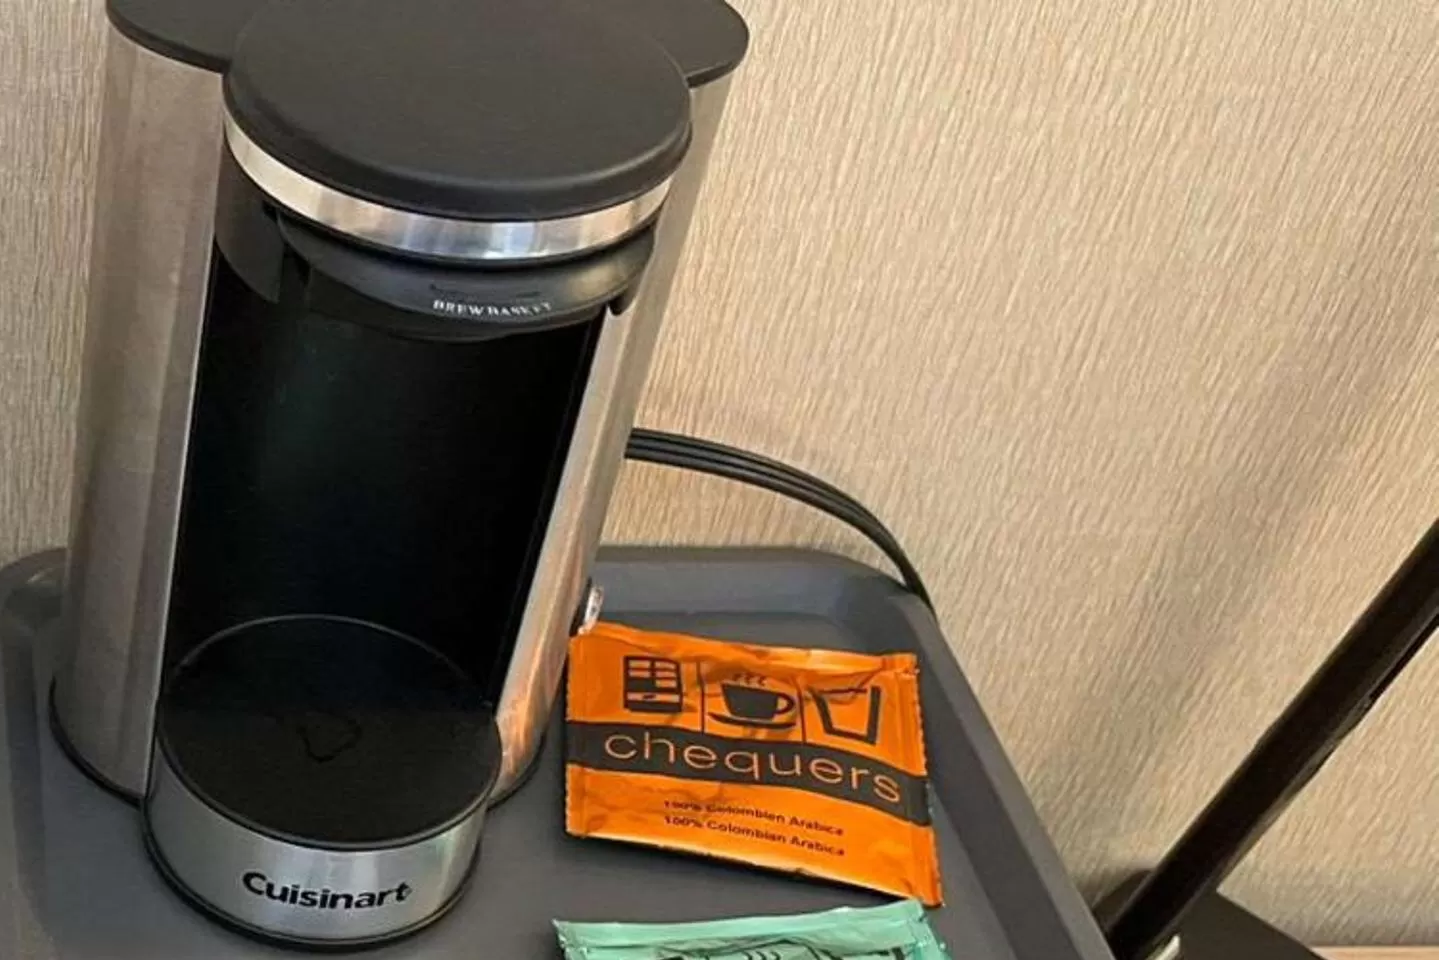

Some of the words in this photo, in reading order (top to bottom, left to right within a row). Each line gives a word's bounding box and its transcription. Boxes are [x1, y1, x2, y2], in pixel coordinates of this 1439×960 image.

[604, 732, 901, 804] chequers
[664, 815, 703, 829] 100%
[790, 836, 846, 857] Arabica
[789, 816, 844, 836] Arabica
[242, 871, 411, 910] Cuisinart
